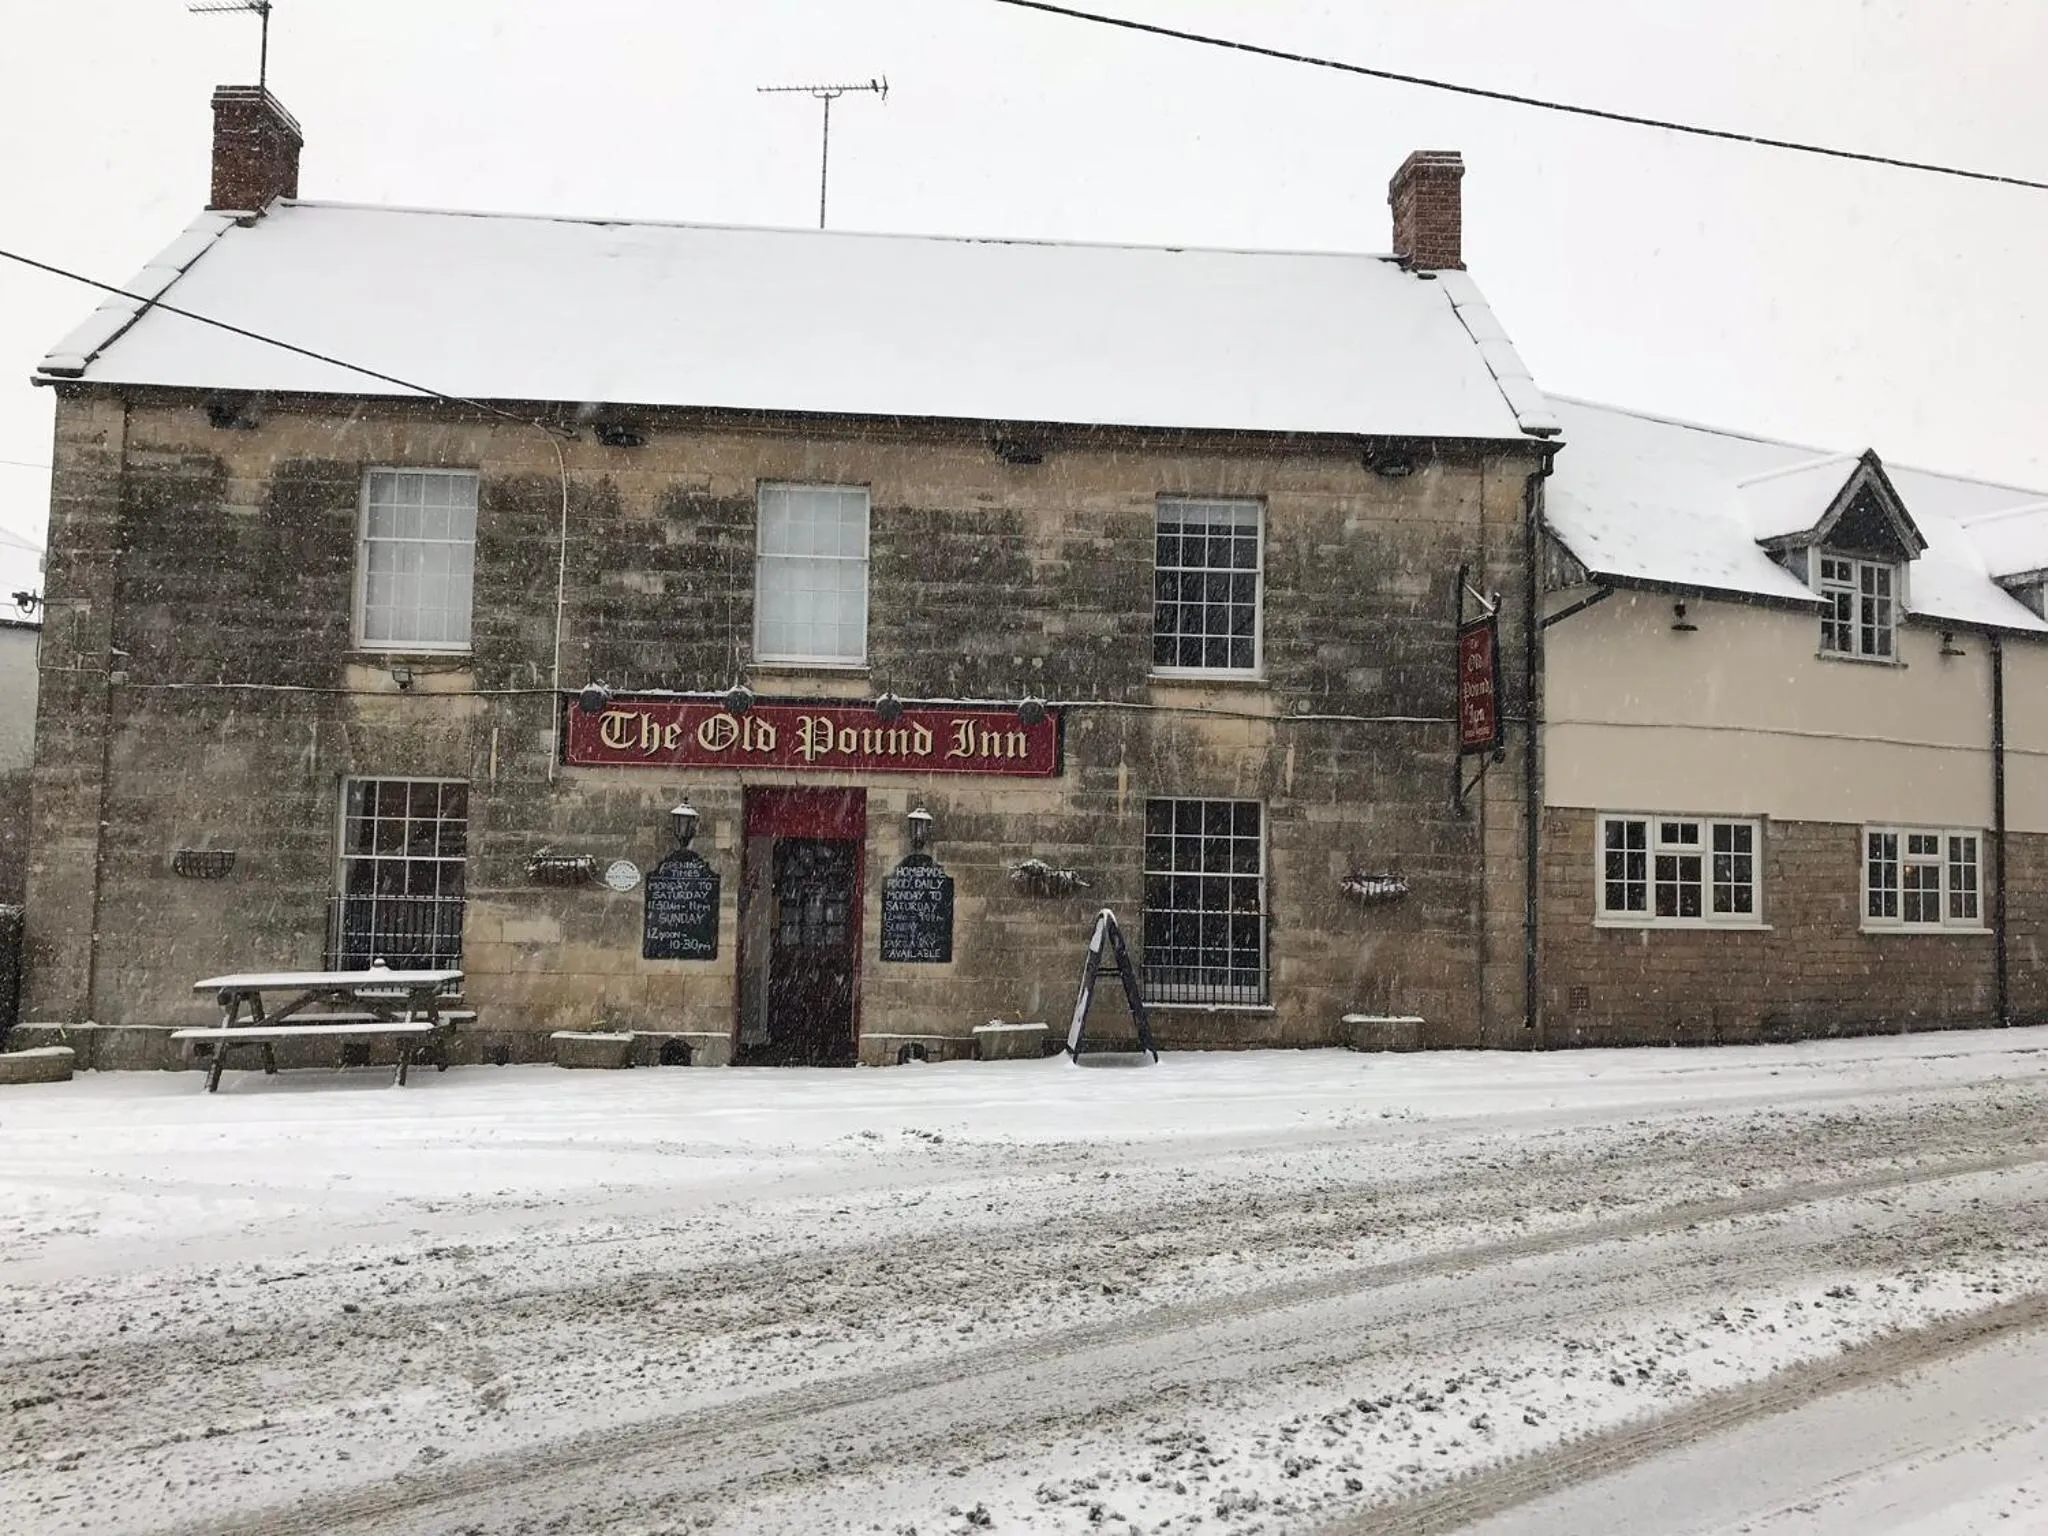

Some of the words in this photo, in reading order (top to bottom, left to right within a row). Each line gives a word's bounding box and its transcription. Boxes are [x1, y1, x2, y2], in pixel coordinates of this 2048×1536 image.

[1464, 678, 1491, 702] Pound
[599, 711, 682, 756] The
[697, 712, 777, 752] Old
[793, 715, 933, 762] Pound
[946, 719, 1029, 759] Inn
[661, 861, 704, 871] OPENING
[671, 869, 700, 877] TIMES
[648, 881, 689, 891] MONDAY
[699, 881, 713, 891] TO
[652, 891, 708, 900] SATURDAY
[887, 891, 925, 900] MONDAY
[929, 891, 942, 900] TO
[886, 901, 938, 912] SATURDAY
[659, 913, 704, 925] SUNDAY
[888, 949, 942, 958] AVAILABLE
